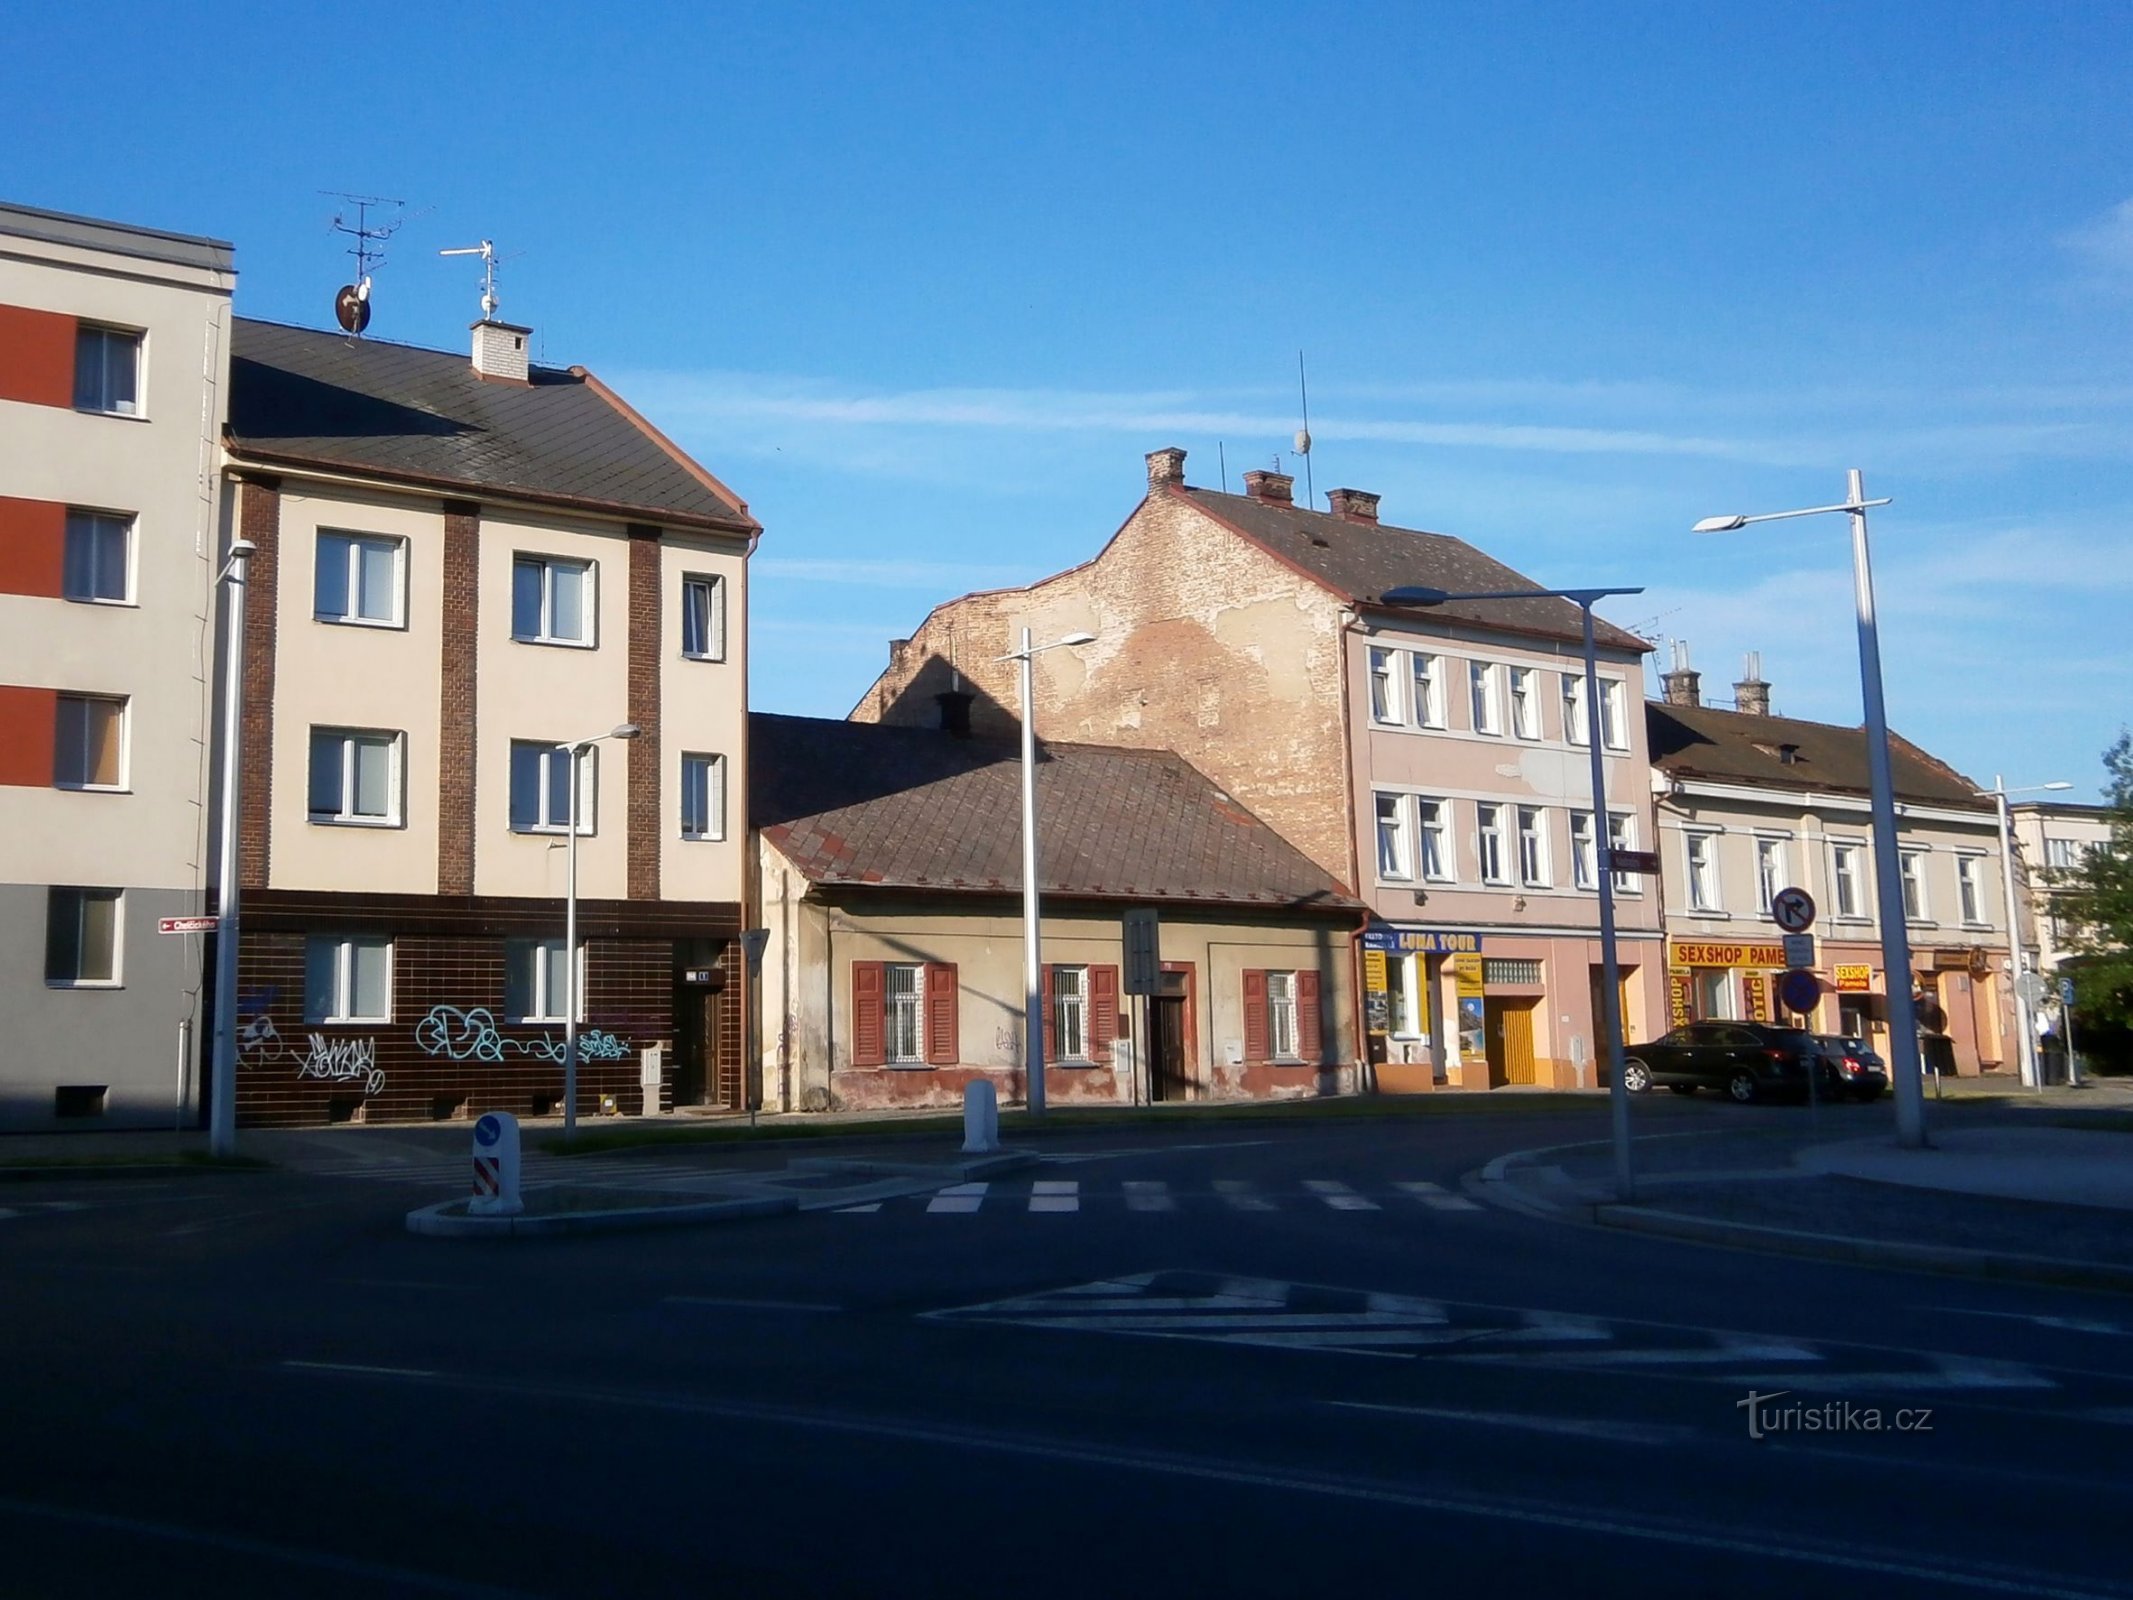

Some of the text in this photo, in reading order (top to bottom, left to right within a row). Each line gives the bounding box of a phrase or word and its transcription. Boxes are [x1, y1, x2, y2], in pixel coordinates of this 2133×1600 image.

[1399, 932, 1437, 950] LUNA
[1440, 934, 1476, 951] TOUR
[1678, 946, 1742, 963] SEXSHOP
[1750, 948, 1785, 965] PAME
[1834, 966, 1870, 979] SEXSHOP
[1750, 978, 1766, 1022] OTIC
